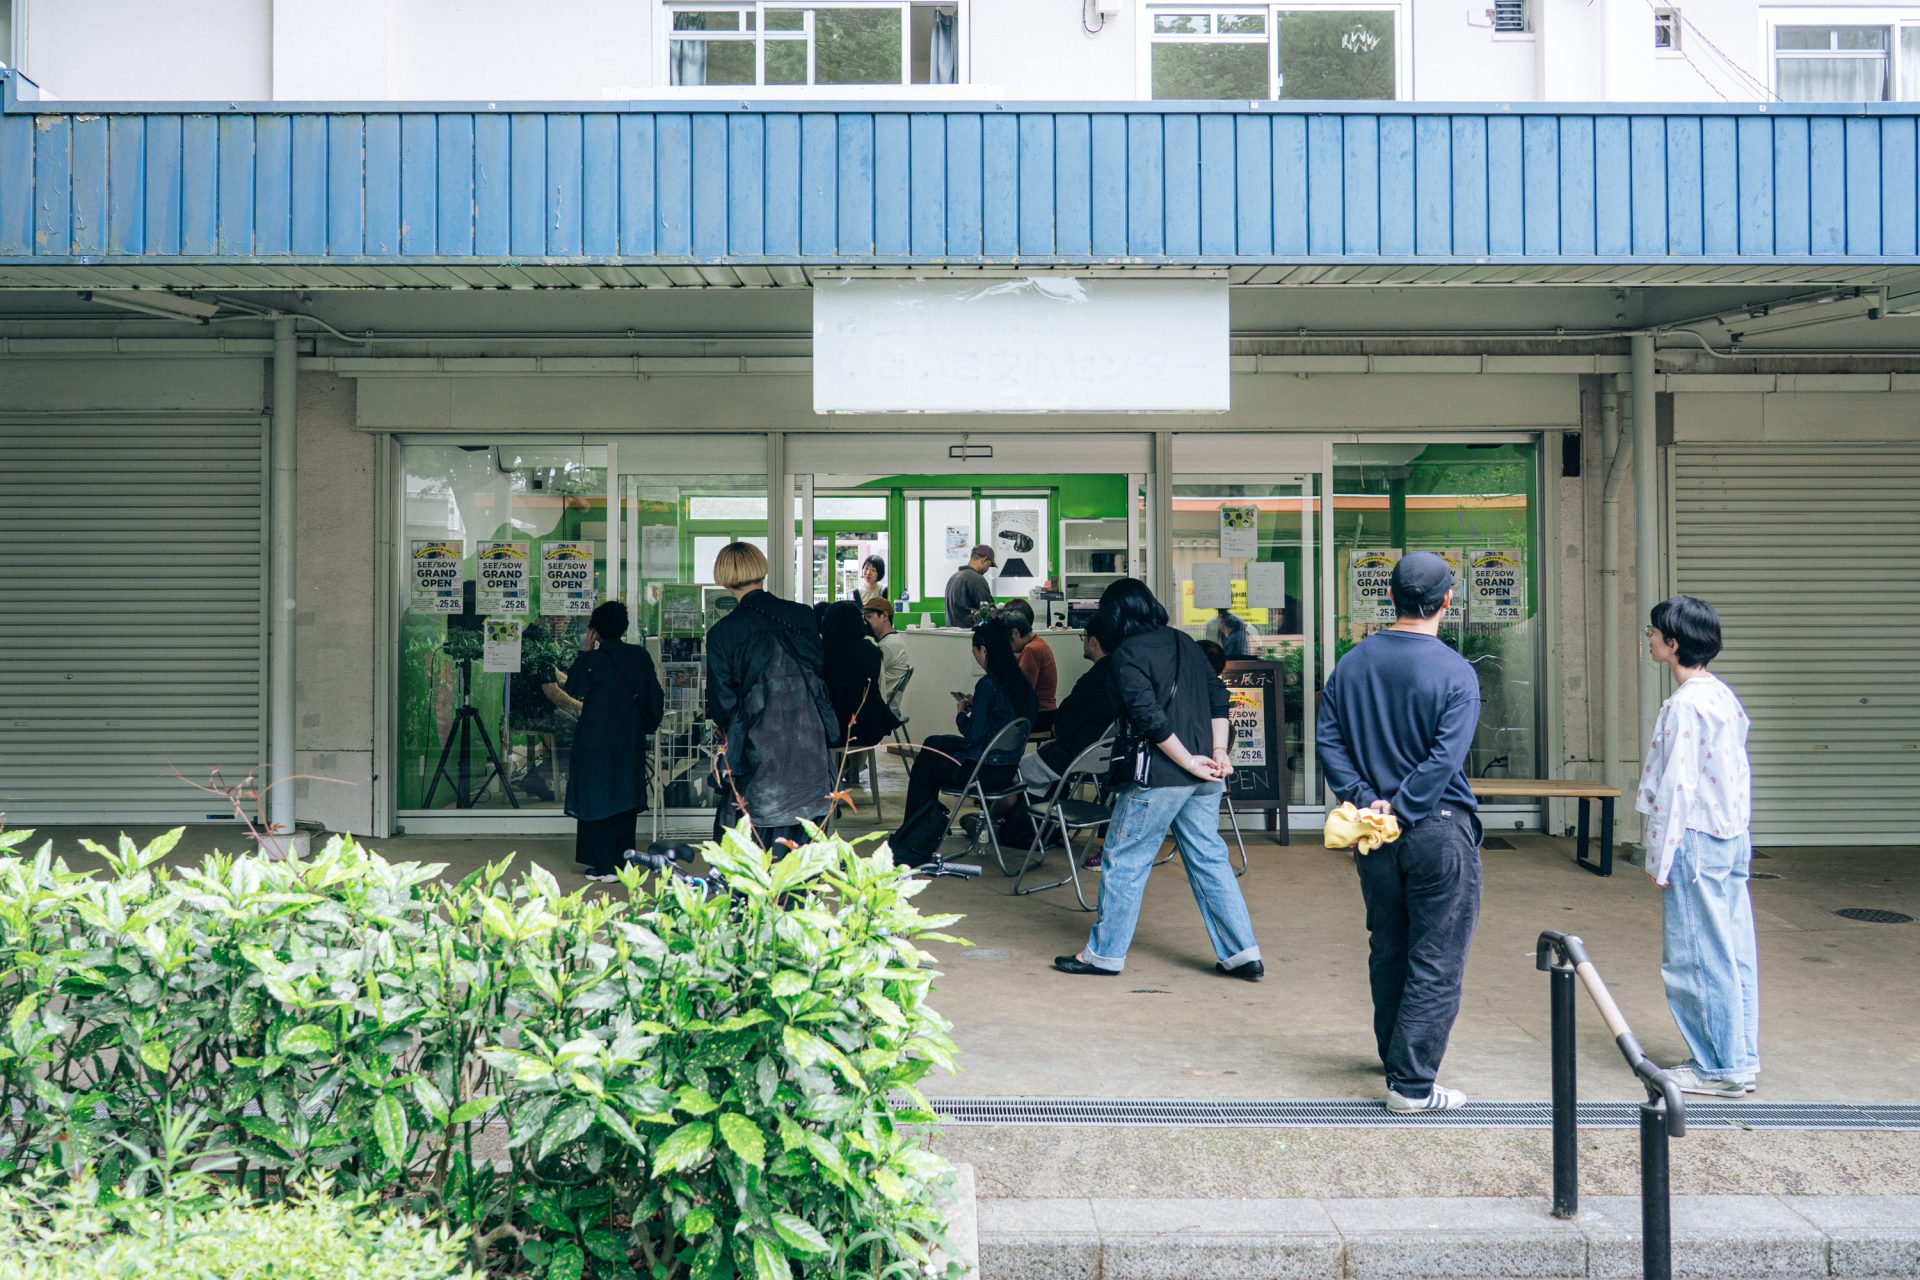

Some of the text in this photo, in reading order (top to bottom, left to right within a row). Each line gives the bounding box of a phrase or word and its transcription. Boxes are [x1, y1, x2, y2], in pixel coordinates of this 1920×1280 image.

[417, 561, 457, 569] SEE/SOW
[483, 562, 522, 570] SEE/SOW
[547, 562, 587, 570] SEE/SOW
[417, 570, 457, 578] GRAND
[483, 570, 522, 578] GRAND
[547, 571, 587, 579] GRAND
[1475, 570, 1515, 578] SEE/SOW
[421, 579, 452, 588] OPEN
[487, 580, 518, 588] OPEN
[552, 580, 583, 589] OPEN
[1475, 578, 1515, 587] GRAND
[1480, 588, 1510, 596] OPEN
[1219, 672, 1272, 686] ェ・展示
[1229, 711, 1257, 719] E/SOW
[1231, 719, 1257, 728] AND
[1227, 769, 1270, 791] PEN
